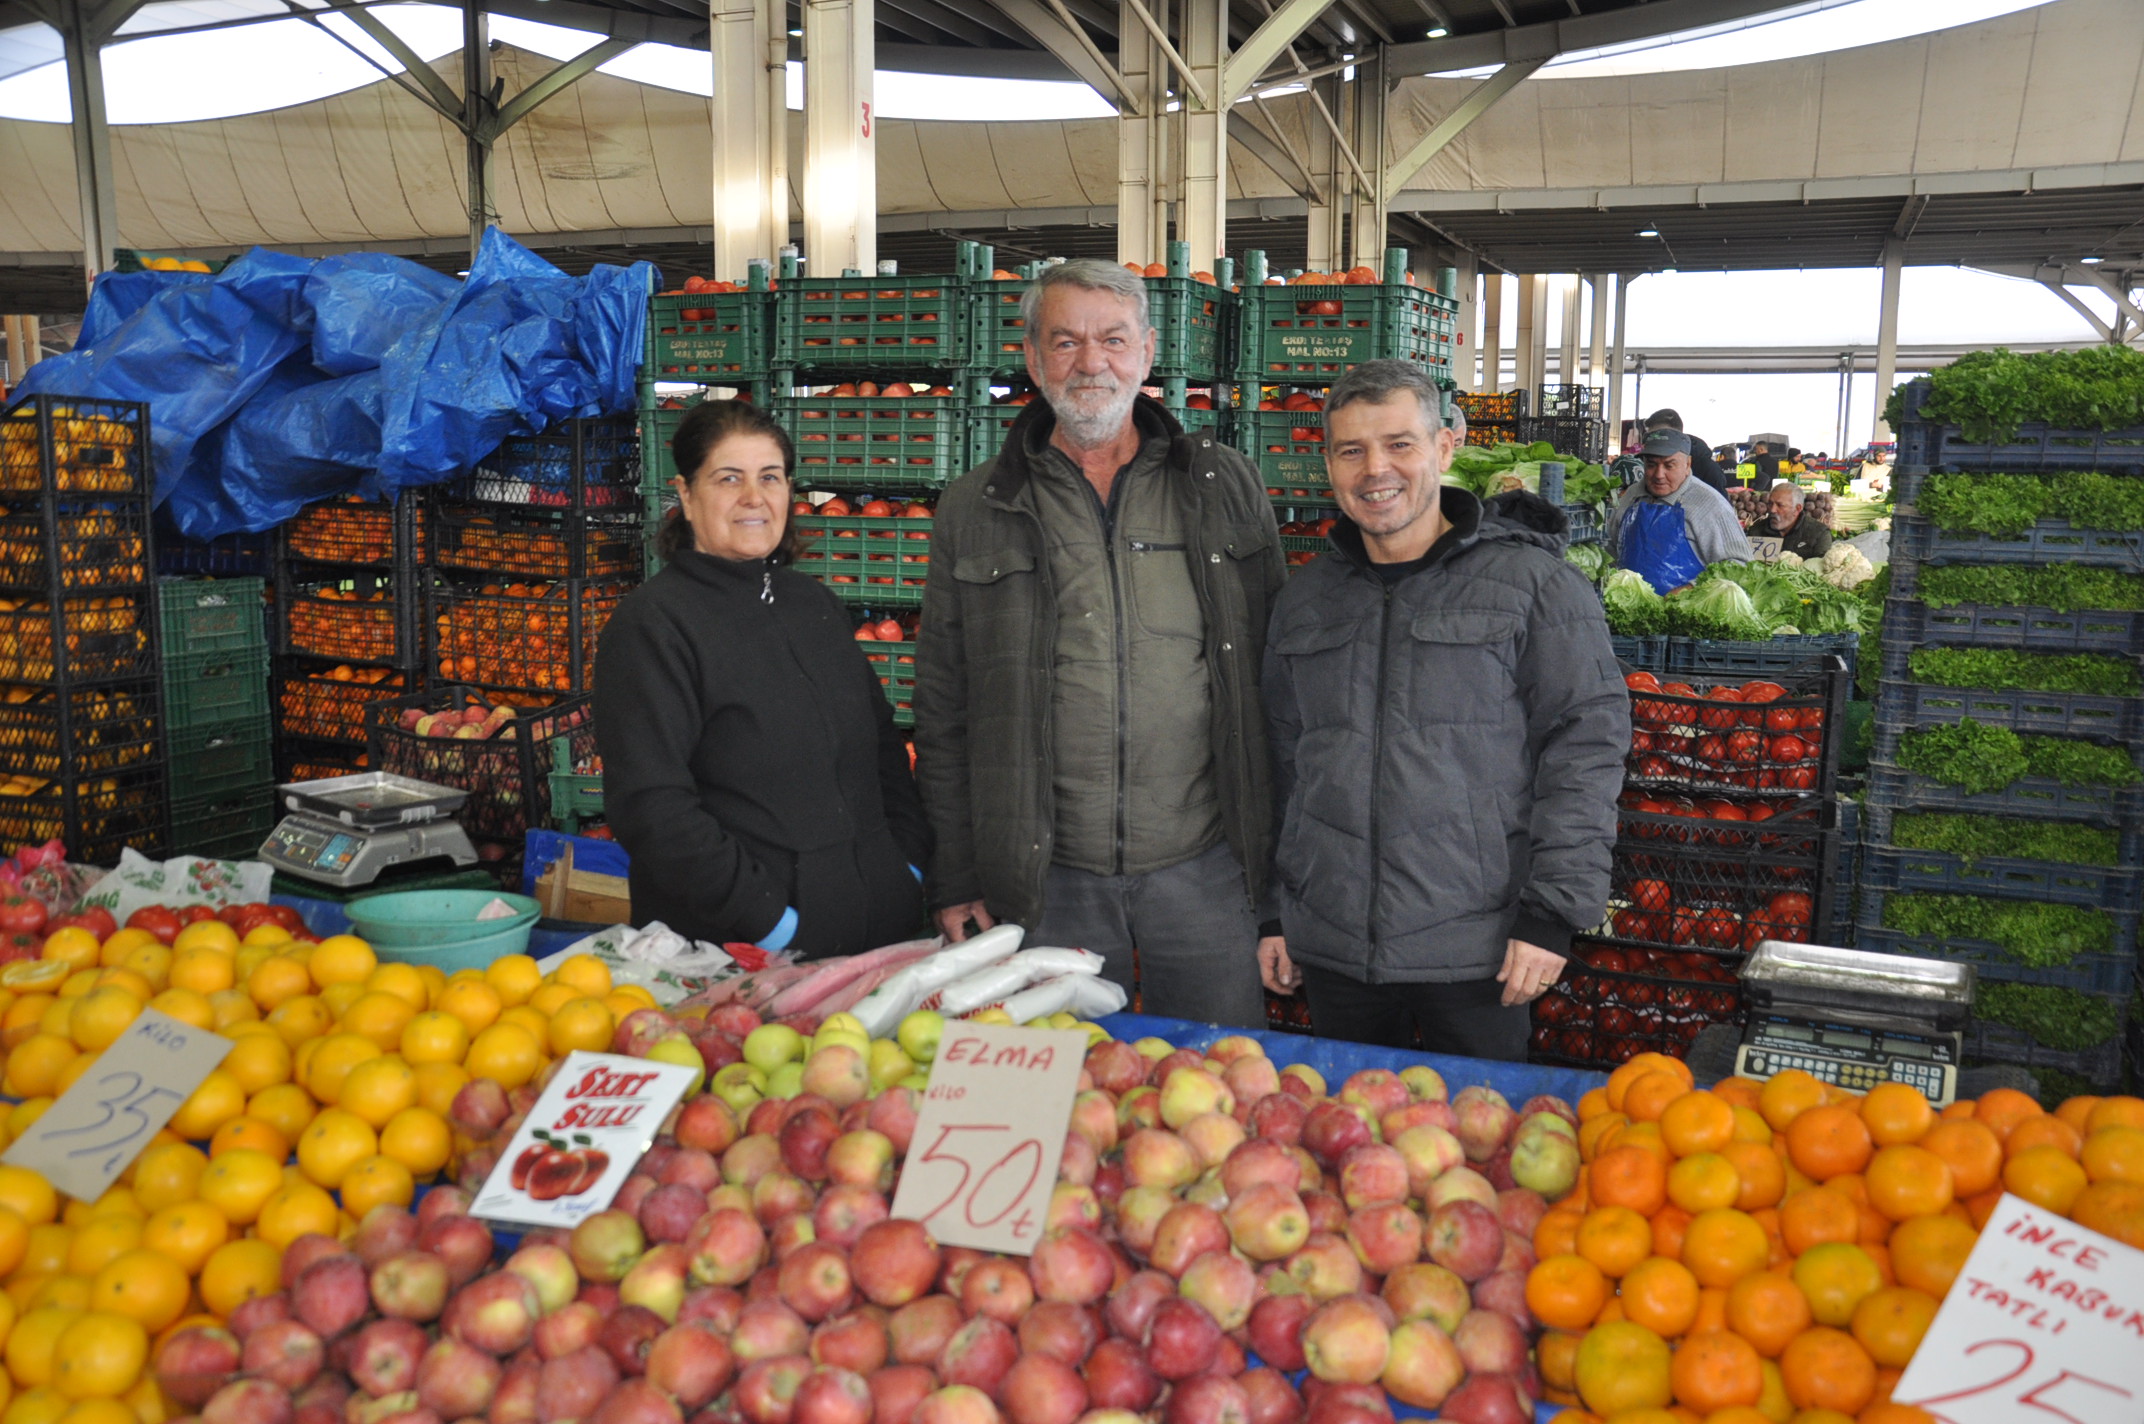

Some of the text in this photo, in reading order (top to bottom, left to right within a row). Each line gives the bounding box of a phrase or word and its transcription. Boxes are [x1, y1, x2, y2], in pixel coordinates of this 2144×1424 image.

[861, 101, 870, 138] 3
[1457, 332, 1463, 345] 6
[1752, 541, 1776, 558] 70
[944, 1037, 1055, 1072] ELMA
[41, 1071, 184, 1158] 35
[552, 1103, 646, 1130] SULU
[919, 1124, 1043, 1229] 50
[1966, 1277, 2068, 1335] TATLI
